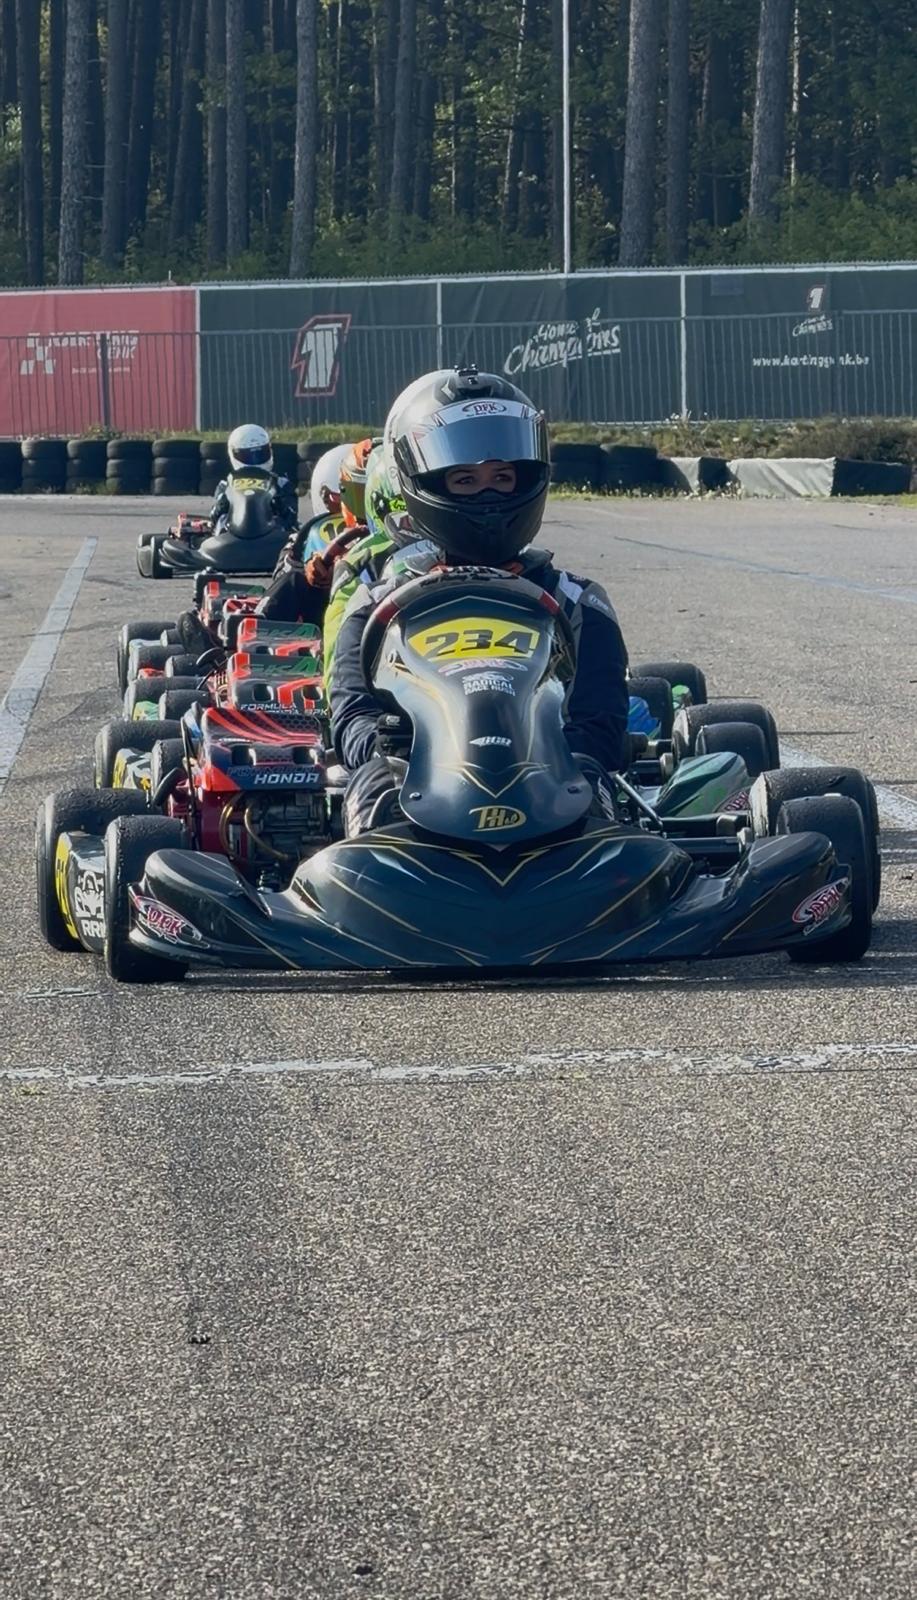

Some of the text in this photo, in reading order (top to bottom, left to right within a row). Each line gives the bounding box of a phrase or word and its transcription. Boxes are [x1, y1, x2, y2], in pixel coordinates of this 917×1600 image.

[424, 630, 532, 658] 234
[240, 703, 297, 711] FORMULA
[254, 773, 319, 784] HONDA
